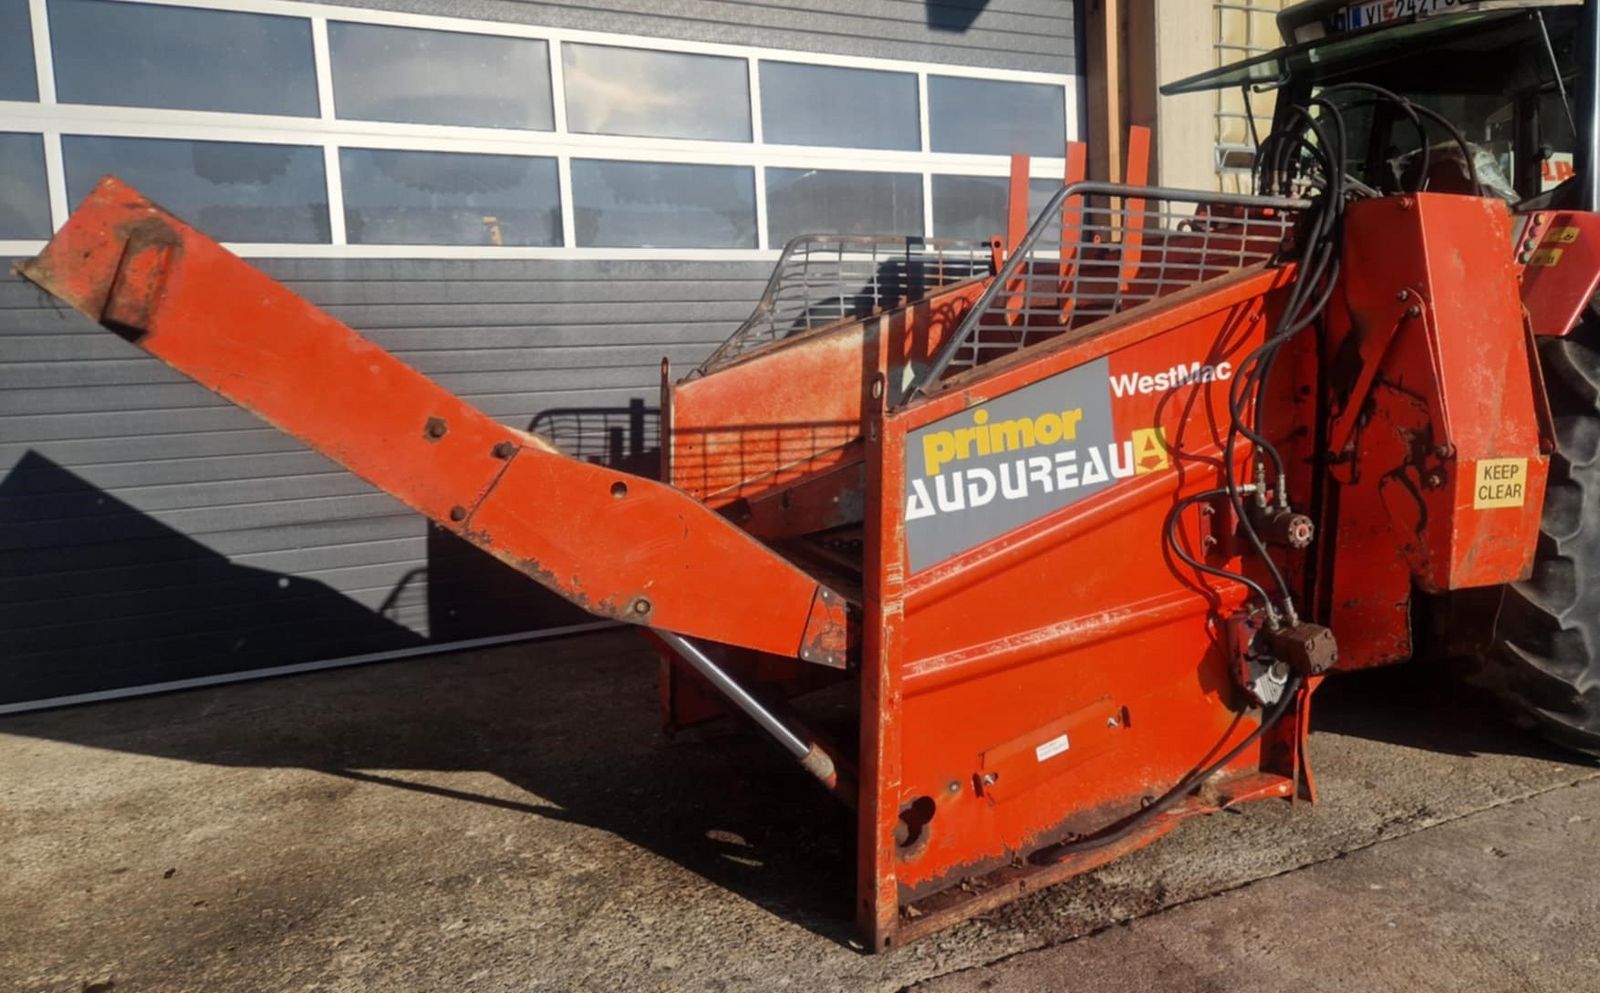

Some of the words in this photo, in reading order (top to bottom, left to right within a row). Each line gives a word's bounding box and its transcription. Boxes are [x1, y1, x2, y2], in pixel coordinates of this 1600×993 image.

[1109, 361, 1232, 398] WestMac
[922, 409, 1083, 476] primor
[905, 441, 1135, 521] AUDUREAU
[1484, 464, 1519, 480] KEEP
[1478, 483, 1522, 500] CLEAR
